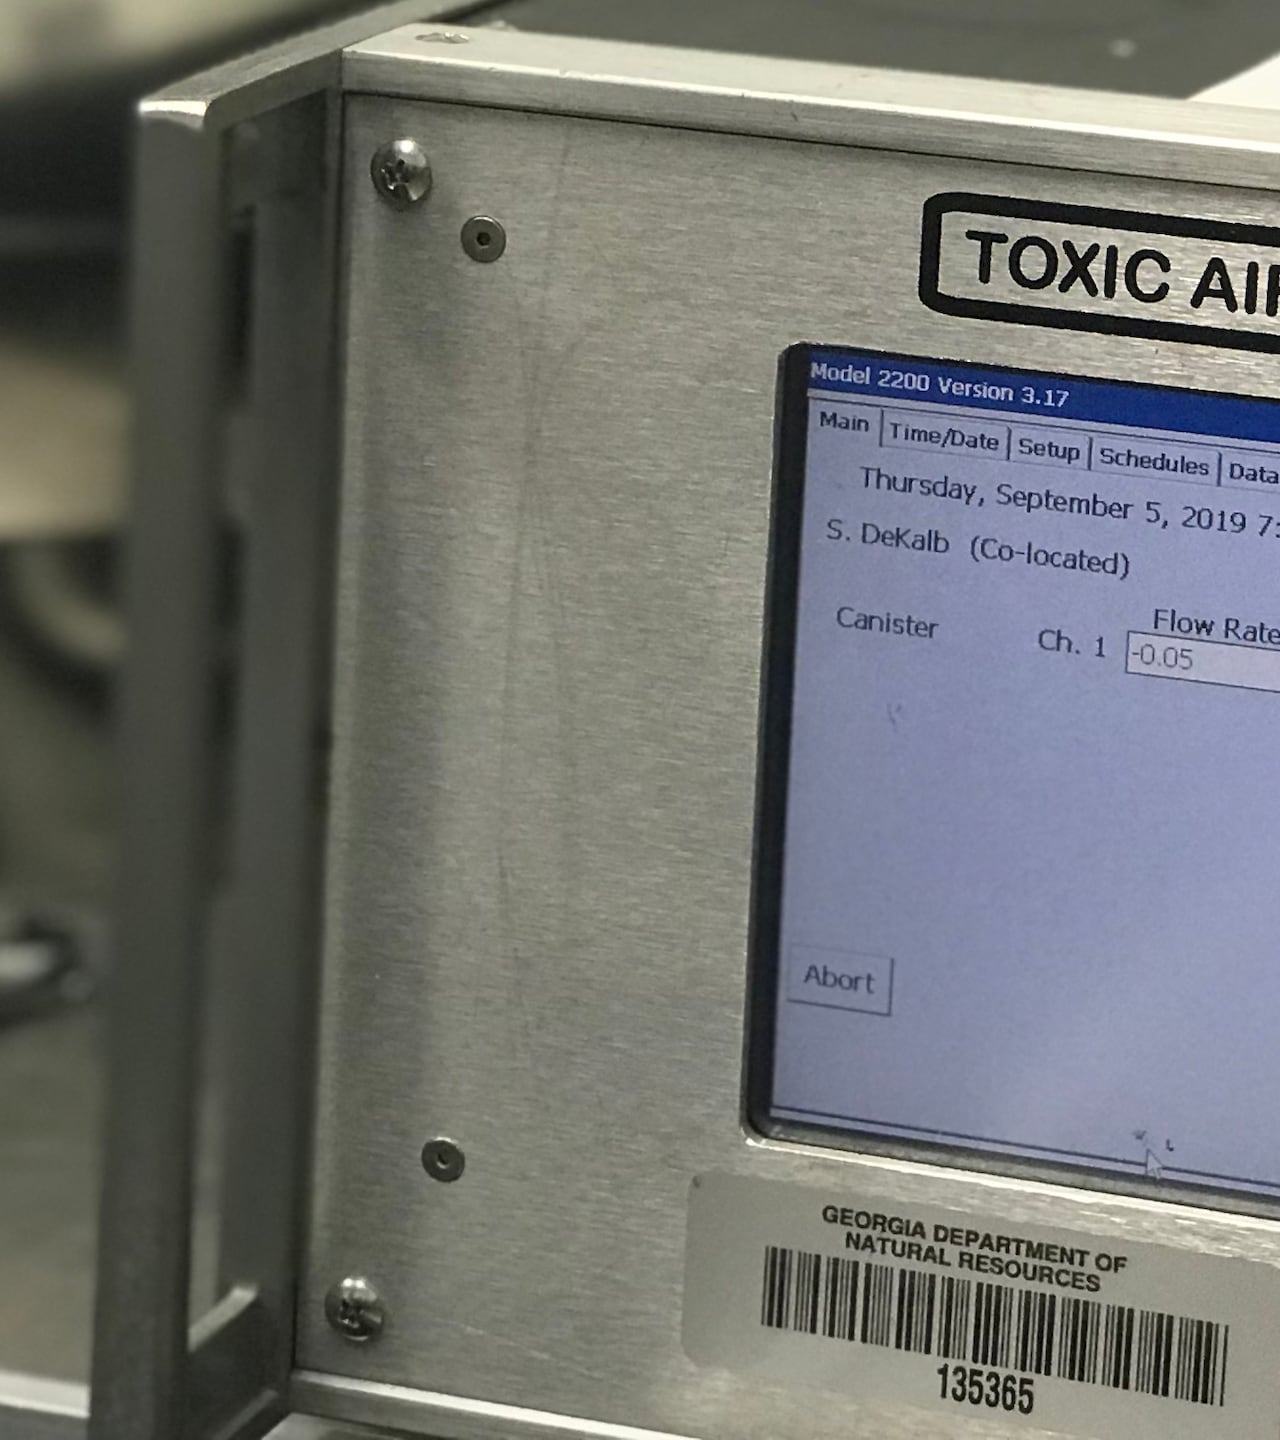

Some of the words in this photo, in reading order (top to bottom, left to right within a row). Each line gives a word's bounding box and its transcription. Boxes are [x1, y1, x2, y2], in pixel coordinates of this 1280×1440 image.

[965, 229, 1172, 305] TOXIC
[810, 361, 871, 387] Model
[878, 370, 930, 392] 2200
[938, 375, 1014, 403] Version
[1022, 386, 1070, 409] 3.17
[819, 410, 870, 433] Main
[890, 421, 1000, 451] Time/Date
[1018, 438, 1081, 465] Setup
[1100, 446, 1210, 477] Schedules
[1229, 463, 1280, 485] Data
[860, 466, 985, 507] Thursday,
[997, 484, 1134, 523] September
[1146, 500, 1169, 529] 5,
[1182, 505, 1247, 534] 2019
[826, 518, 852, 543] S.
[861, 522, 950, 555] DeKalb
[970, 533, 1130, 581] (Co-located)
[836, 606, 939, 640] Canister
[1154, 608, 1215, 638] Flow
[1038, 628, 1081, 655] Ch.
[1095, 636, 1107, 658] 1
[1131, 644, 1194, 671] -0.05
[803, 964, 876, 995] Abort
[822, 1205, 927, 1240] GEORGIA
[933, 1224, 1090, 1268] DEPARTMENT
[1094, 1252, 1128, 1275] OF
[844, 1231, 953, 1268] NATURAL
[959, 1249, 1101, 1293] RESOURCES
[936, 1363, 1035, 1415] 135365
